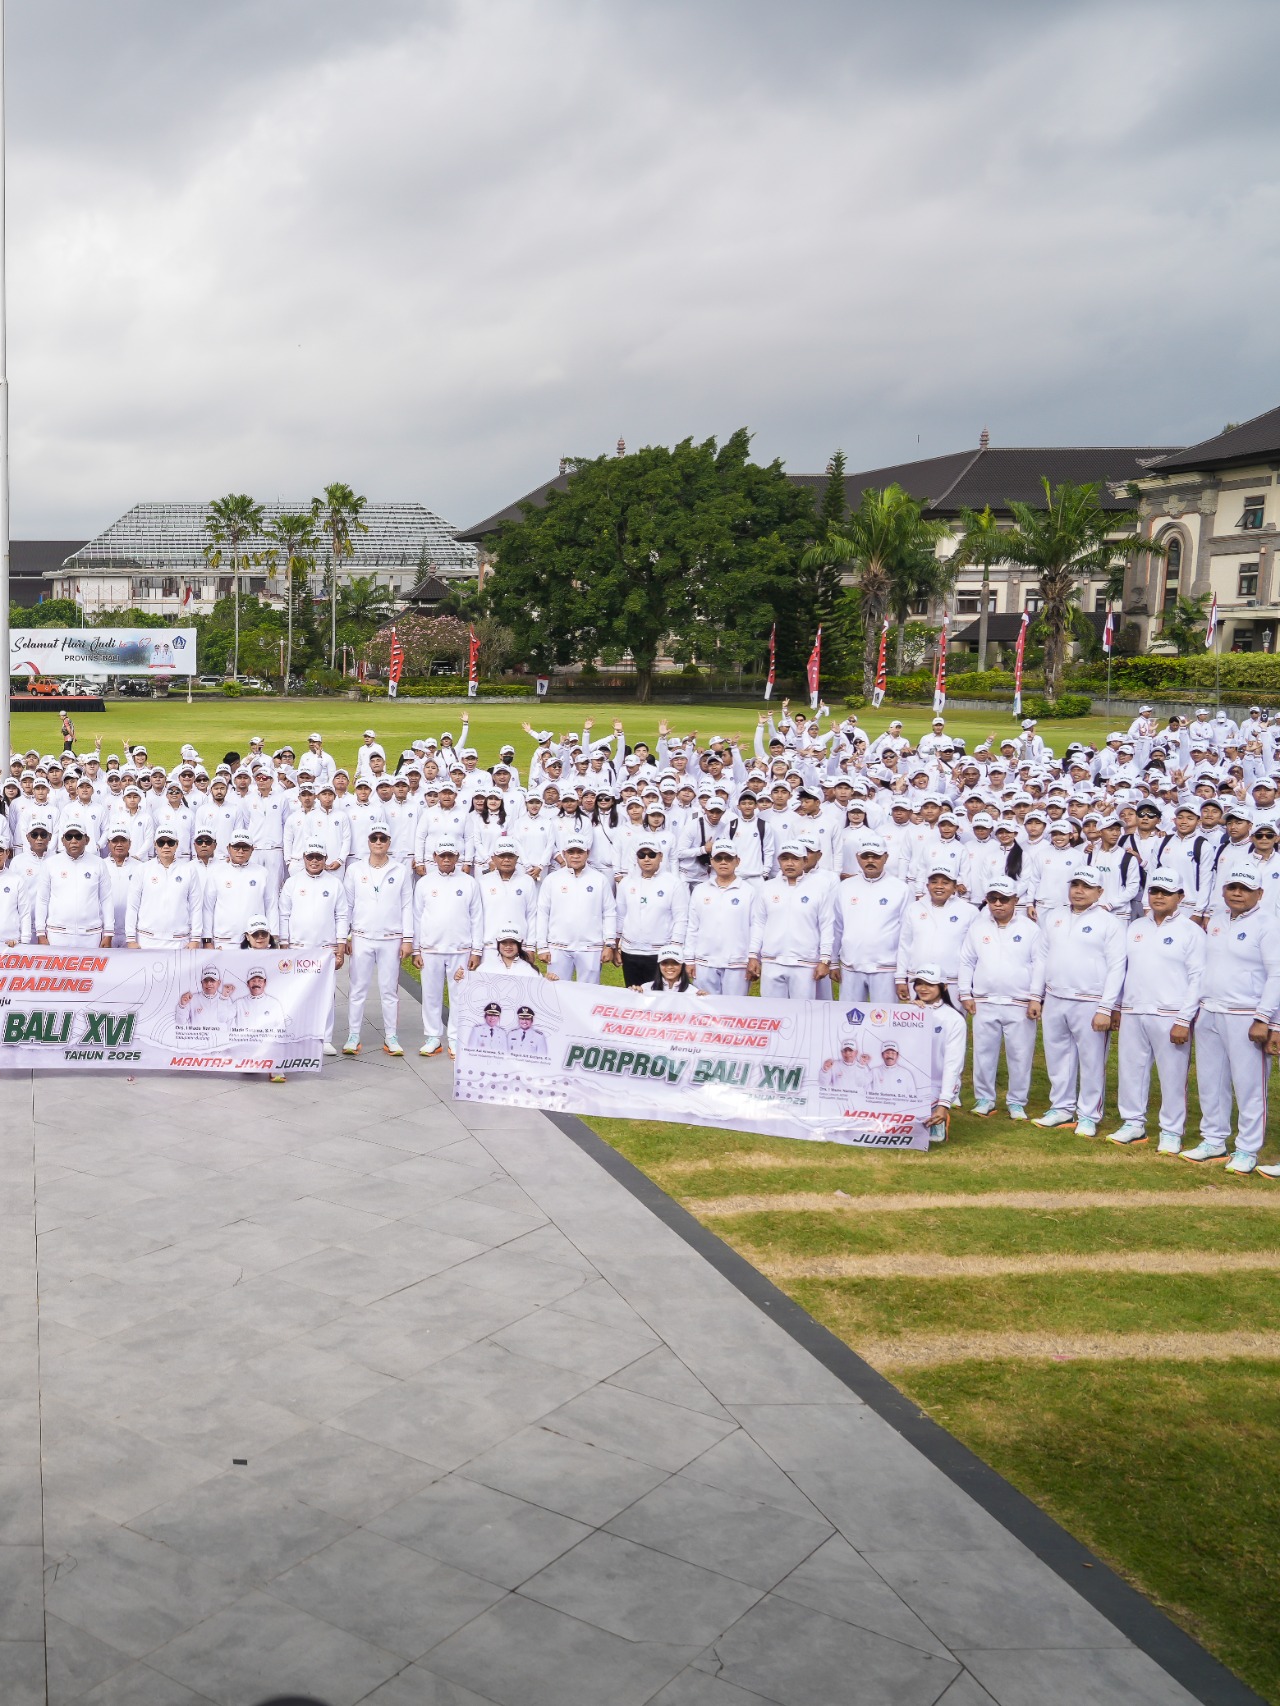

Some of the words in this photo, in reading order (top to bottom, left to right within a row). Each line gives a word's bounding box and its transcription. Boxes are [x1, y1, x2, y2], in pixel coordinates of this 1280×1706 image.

[11, 637, 59, 652] Selamat
[61, 637, 86, 651] Hari
[89, 636, 116, 651] Jadi
[9, 976, 93, 993] BADUNG
[591, 1005, 686, 1026] PELEPASAN
[690, 1014, 782, 1031] KONTINGEN
[892, 1011, 925, 1021] KONI
[2, 1010, 72, 1044] BALI
[80, 1011, 138, 1048] XVI
[602, 1022, 697, 1042] KABUPATEN
[700, 1032, 768, 1048] BADUNG
[64, 1051, 104, 1060] TAHUN
[108, 1051, 141, 1060] 2025
[670, 1045, 702, 1054] Menuju
[170, 1057, 233, 1068] MANTAP
[235, 1059, 274, 1069] JIWA
[276, 1059, 320, 1069] JUARA
[563, 1043, 689, 1084] PORPROV
[690, 1057, 751, 1088] BALI
[756, 1064, 805, 1094] XVI
[843, 1110, 916, 1124] MANTAP
[853, 1134, 914, 1145] JUARA
